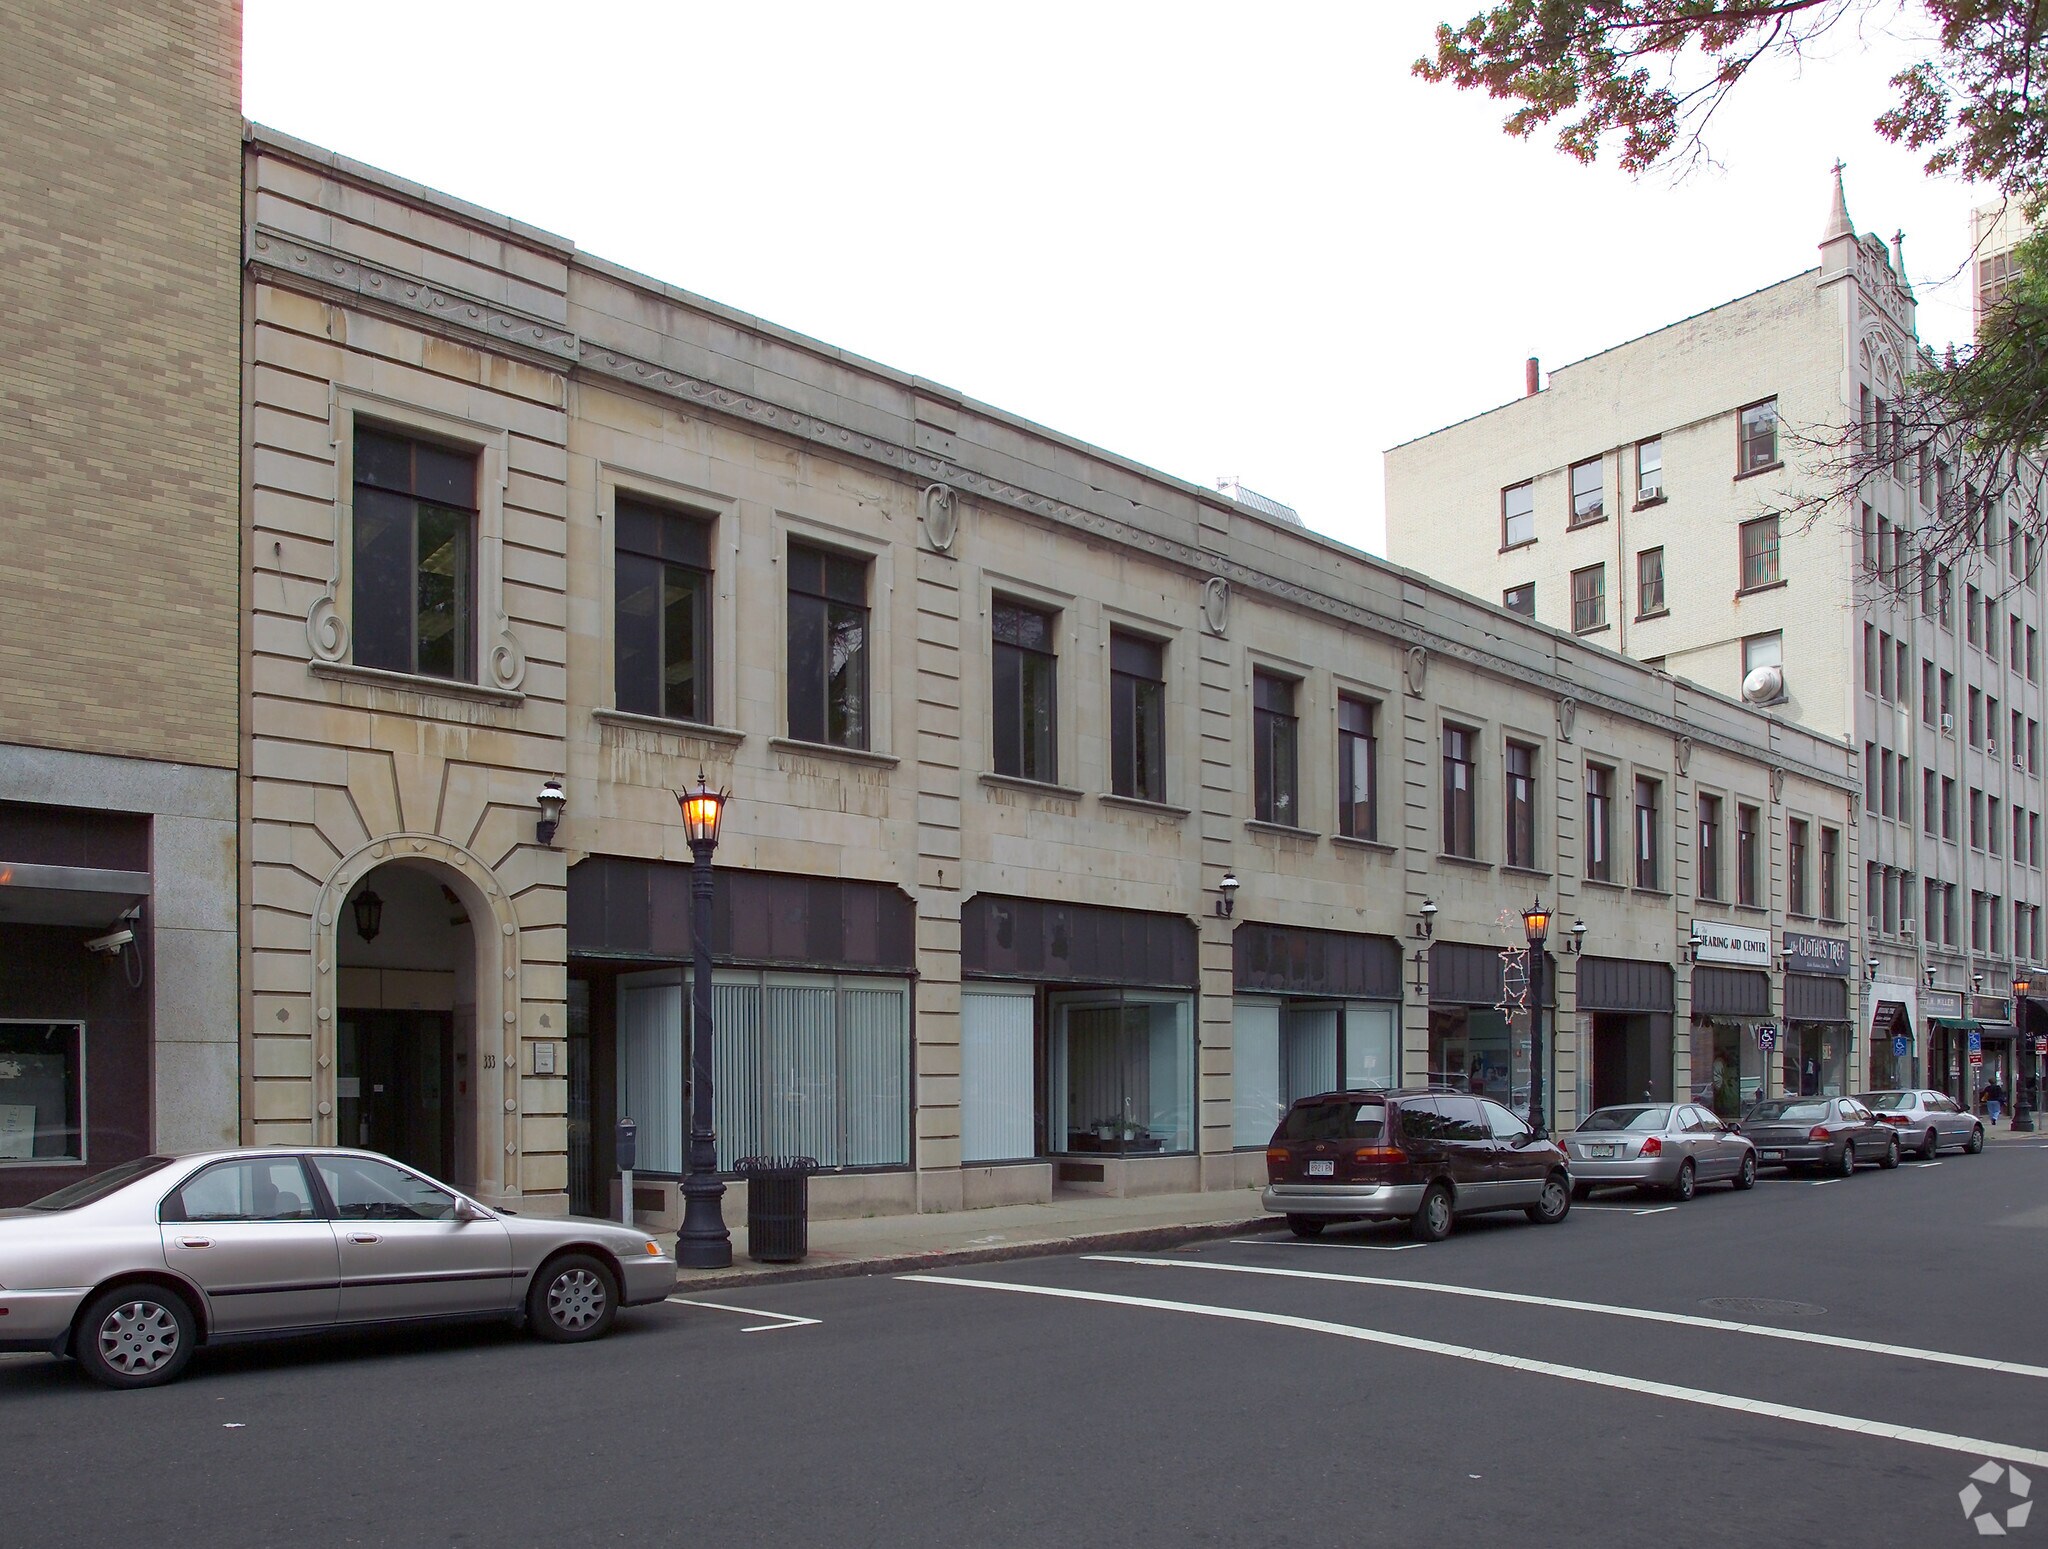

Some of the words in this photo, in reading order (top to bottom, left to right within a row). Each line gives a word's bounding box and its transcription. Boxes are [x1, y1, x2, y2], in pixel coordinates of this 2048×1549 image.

[1700, 934, 1728, 949] HEARING
[1731, 939, 1741, 950] AID
[1743, 940, 1766, 953] CENTER
[483, 1054, 495, 1069] 333
